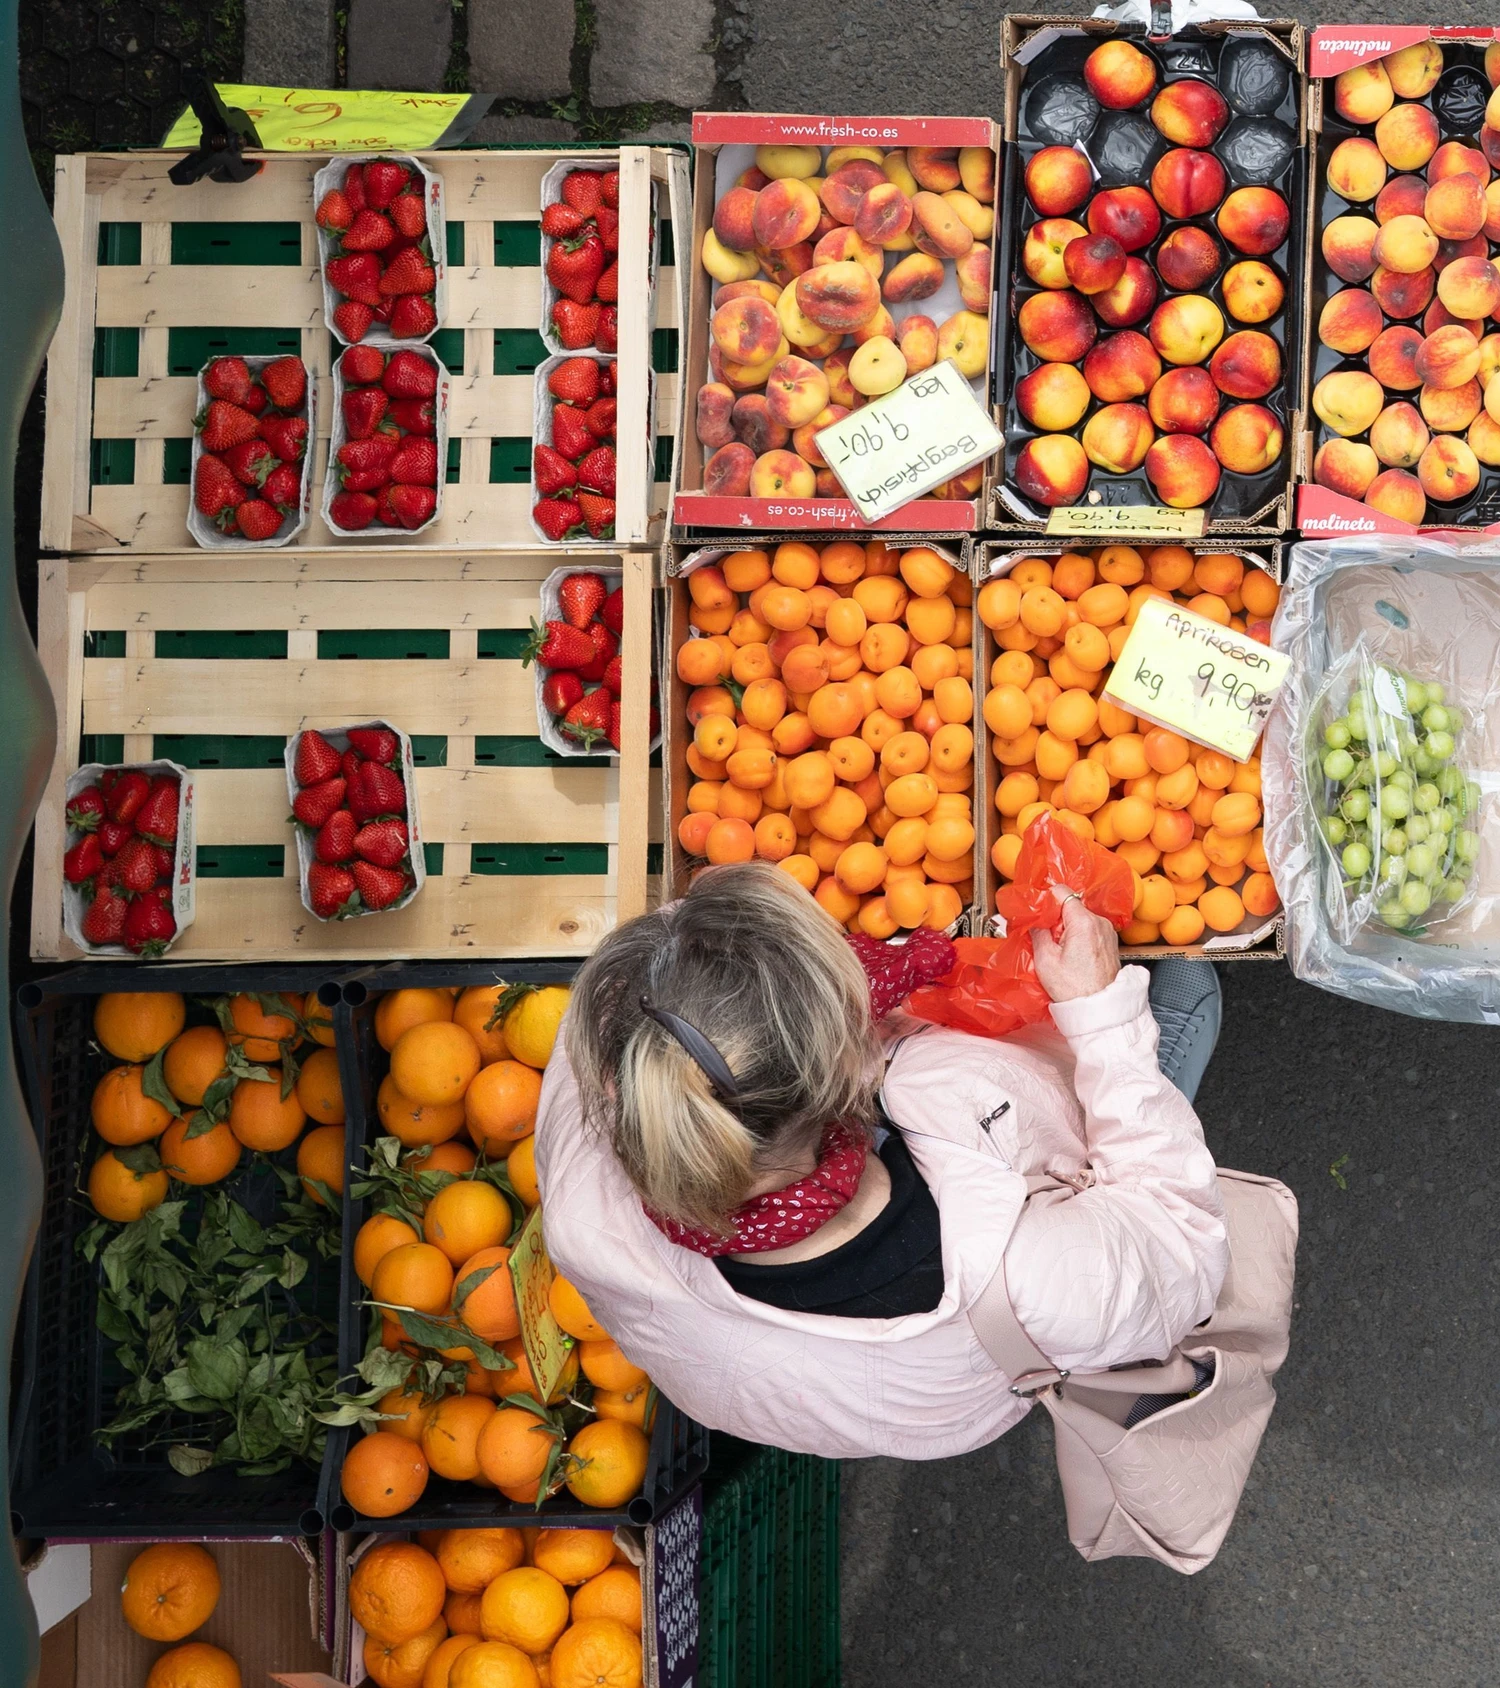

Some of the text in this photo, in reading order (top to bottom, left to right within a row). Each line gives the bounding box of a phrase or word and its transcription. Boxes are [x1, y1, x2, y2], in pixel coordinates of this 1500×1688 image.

[1317, 38, 1392, 57] molineta
[780, 121, 899, 140] www.fresh-co.es
[908, 375, 950, 399] kg
[857, 434, 978, 506] Bergpfirsich
[767, 505, 862, 521] w.fresh-co.es
[1302, 513, 1376, 532] molineta
[1165, 612, 1271, 673] Aprikosen
[1134, 657, 1164, 701] kg
